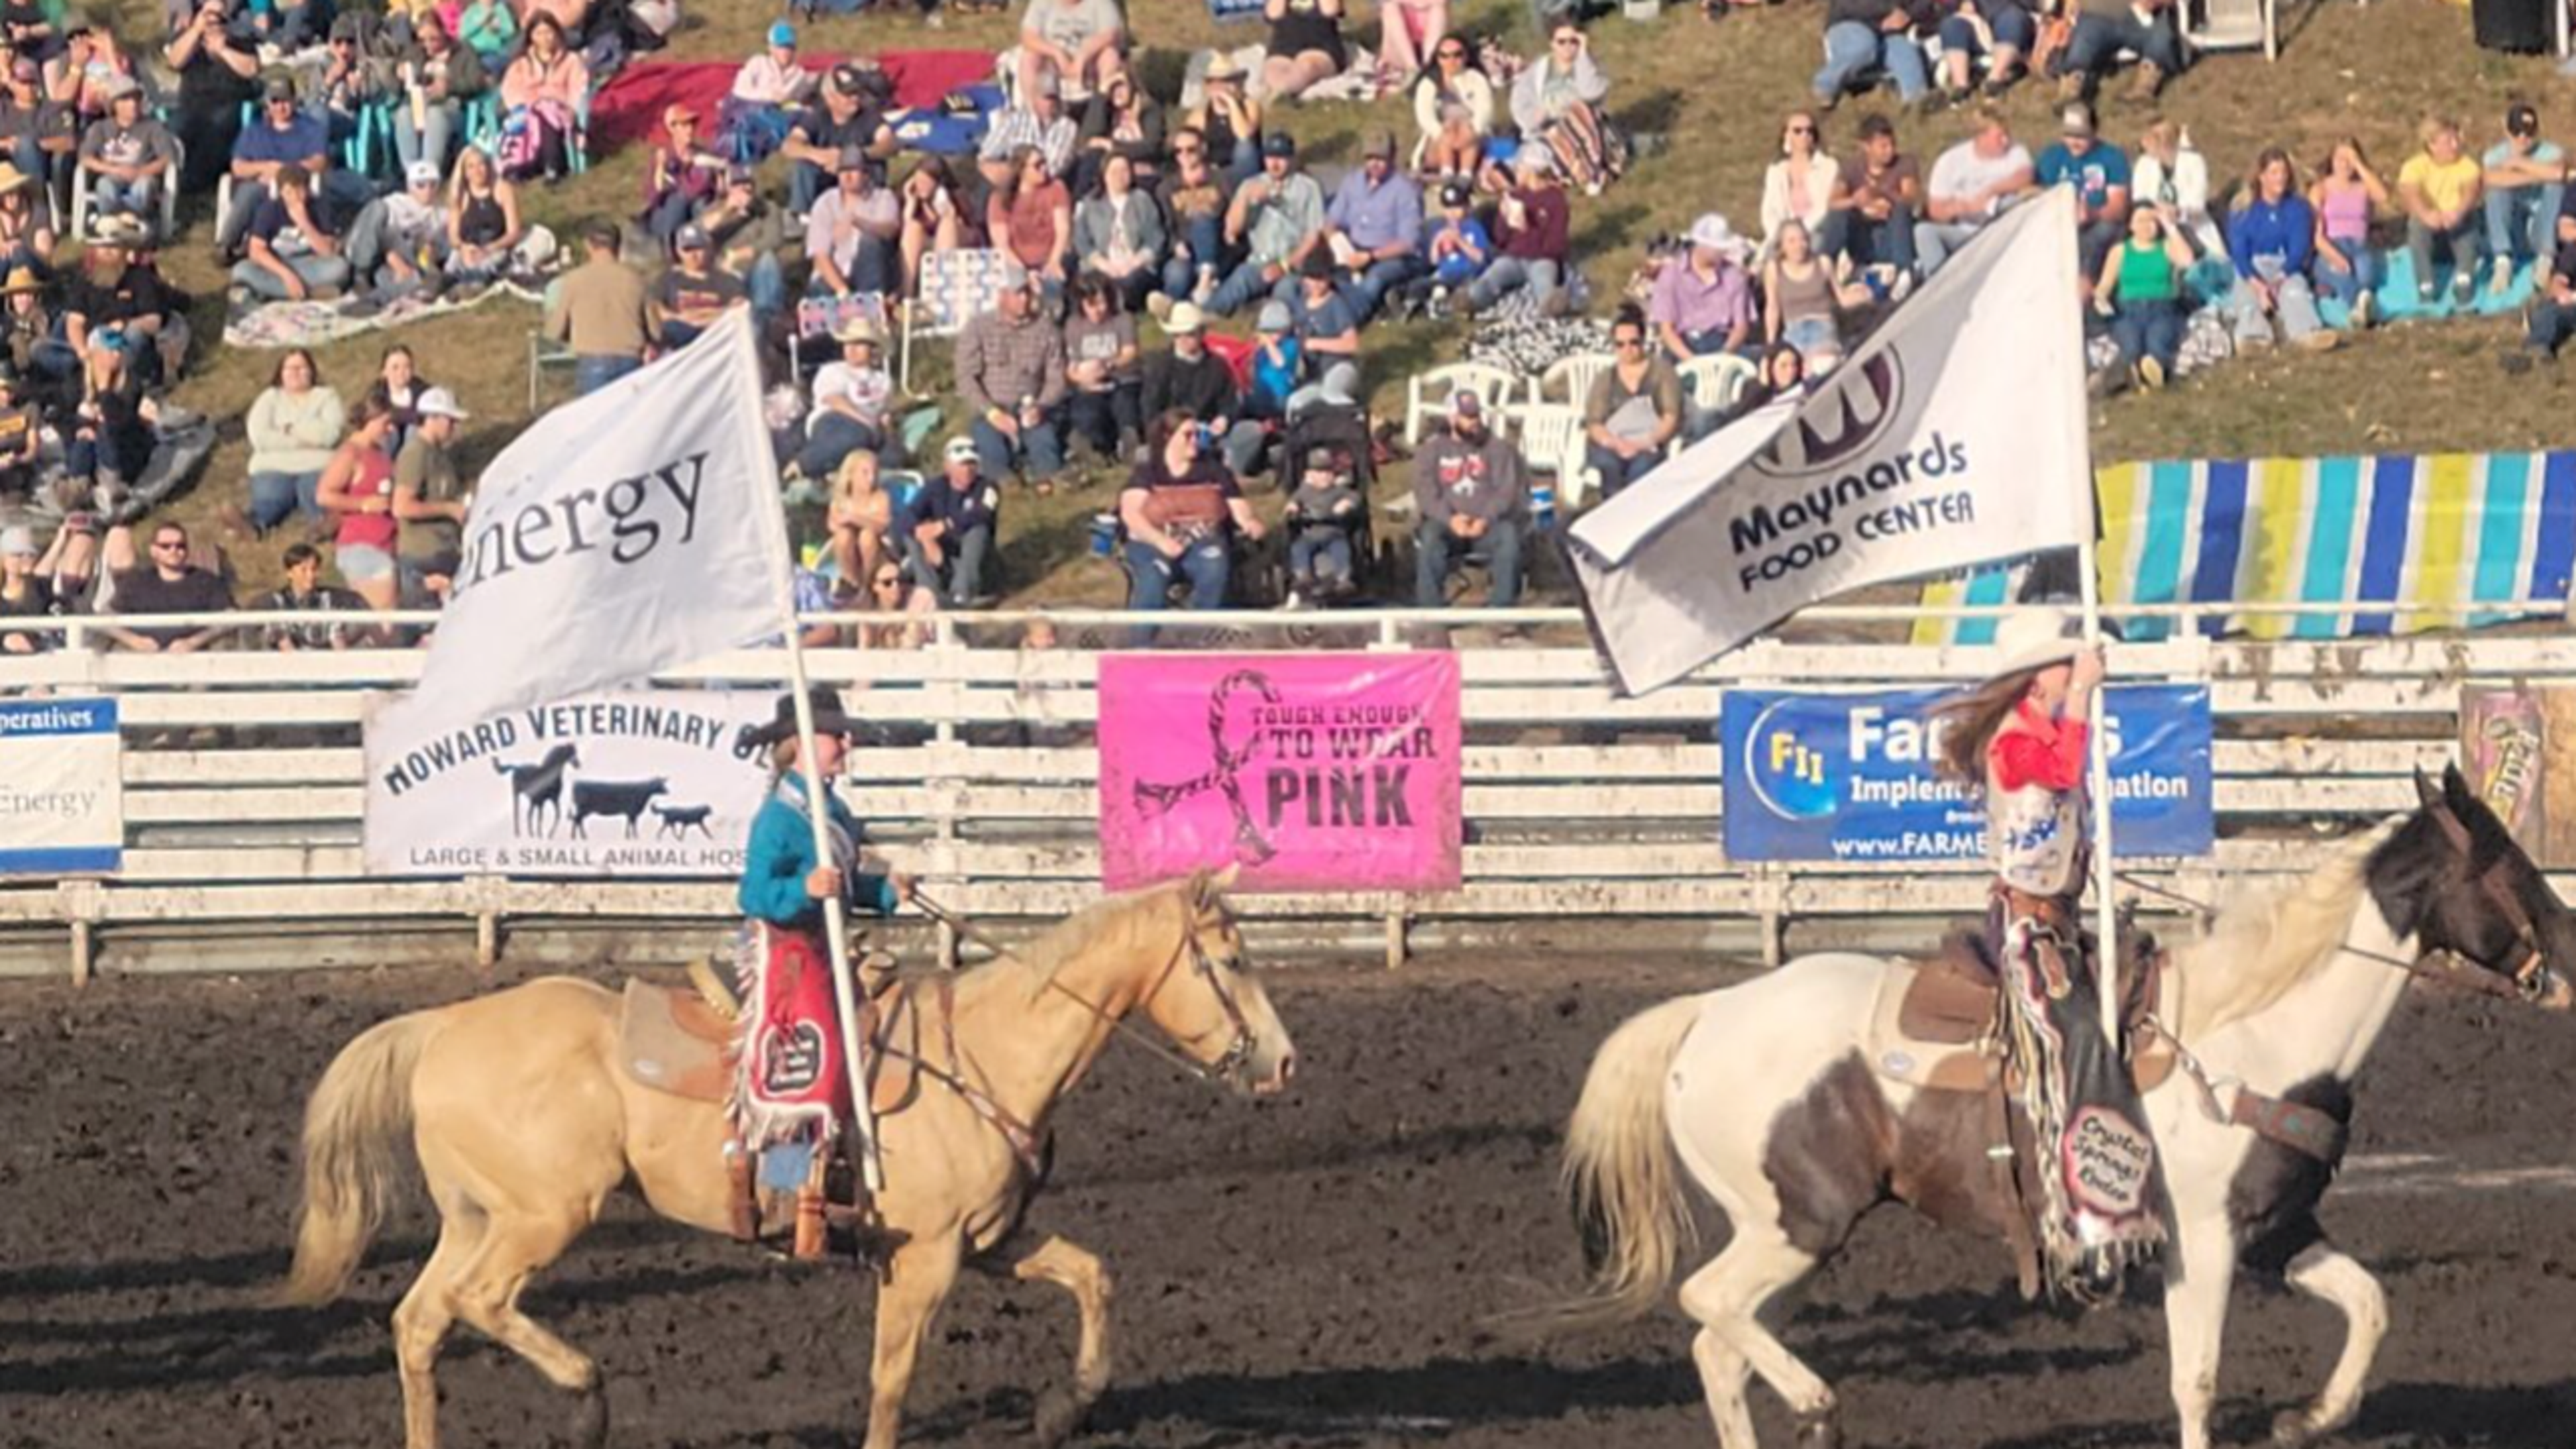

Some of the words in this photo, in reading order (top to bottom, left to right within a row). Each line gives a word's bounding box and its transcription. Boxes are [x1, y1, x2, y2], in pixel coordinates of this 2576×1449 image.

[1729, 432, 1967, 554] Maynards
[468, 451, 709, 587] nergy
[1739, 532, 1841, 594] FOOD
[1856, 491, 1974, 541] CENTER
[527, 704, 724, 749] VETERINARY
[1251, 706, 1325, 725] TOUGH
[1269, 727, 1313, 759] TO
[1328, 727, 1436, 759] WEAR
[1267, 764, 1413, 828] PINK
[1851, 773, 1980, 808] Implem
[410, 848, 487, 866] LARGE
[496, 849, 510, 865] &
[519, 849, 594, 865] SMALL
[604, 849, 691, 865] ANIMAL
[700, 849, 747, 866] HOS
[1832, 832, 1988, 858] www.FARME
